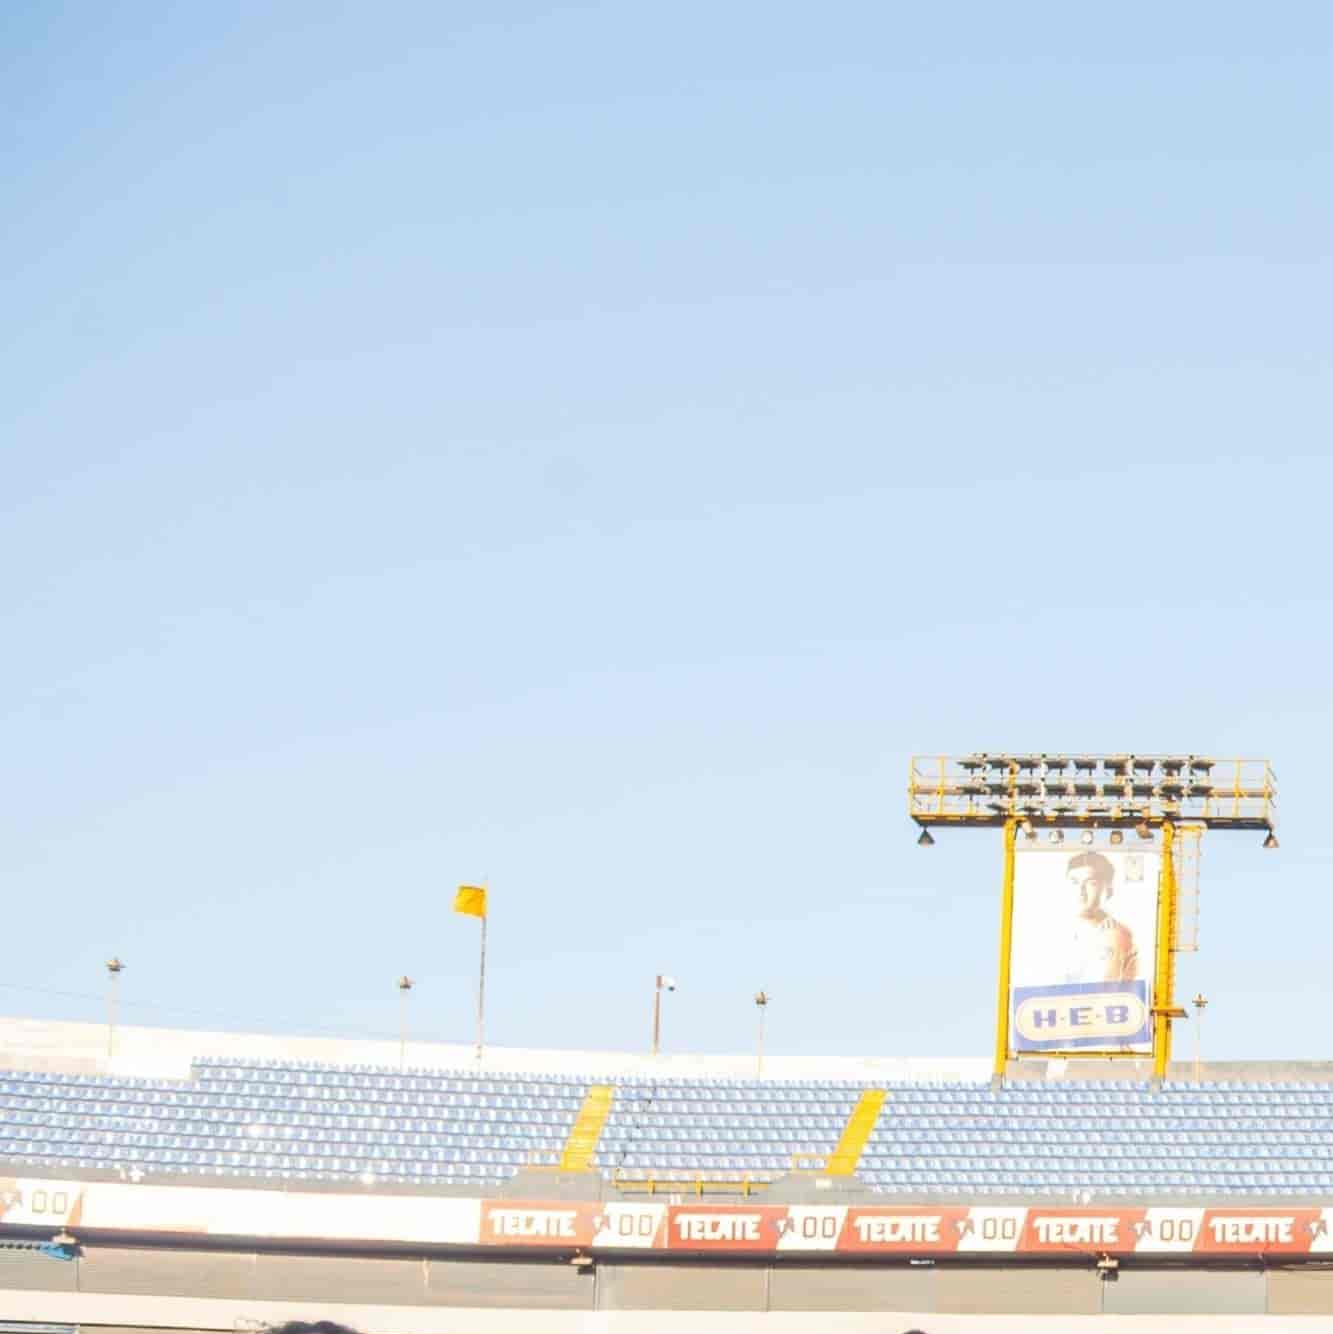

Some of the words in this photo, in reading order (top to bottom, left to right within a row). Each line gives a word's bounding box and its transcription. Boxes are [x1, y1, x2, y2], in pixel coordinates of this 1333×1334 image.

[488, 1210, 577, 1238] TECATE
[674, 1213, 762, 1241] TECATE
[854, 1215, 942, 1243] TECATE
[1032, 1216, 1120, 1244] TECATE
[1208, 1216, 1297, 1243] TECATE
